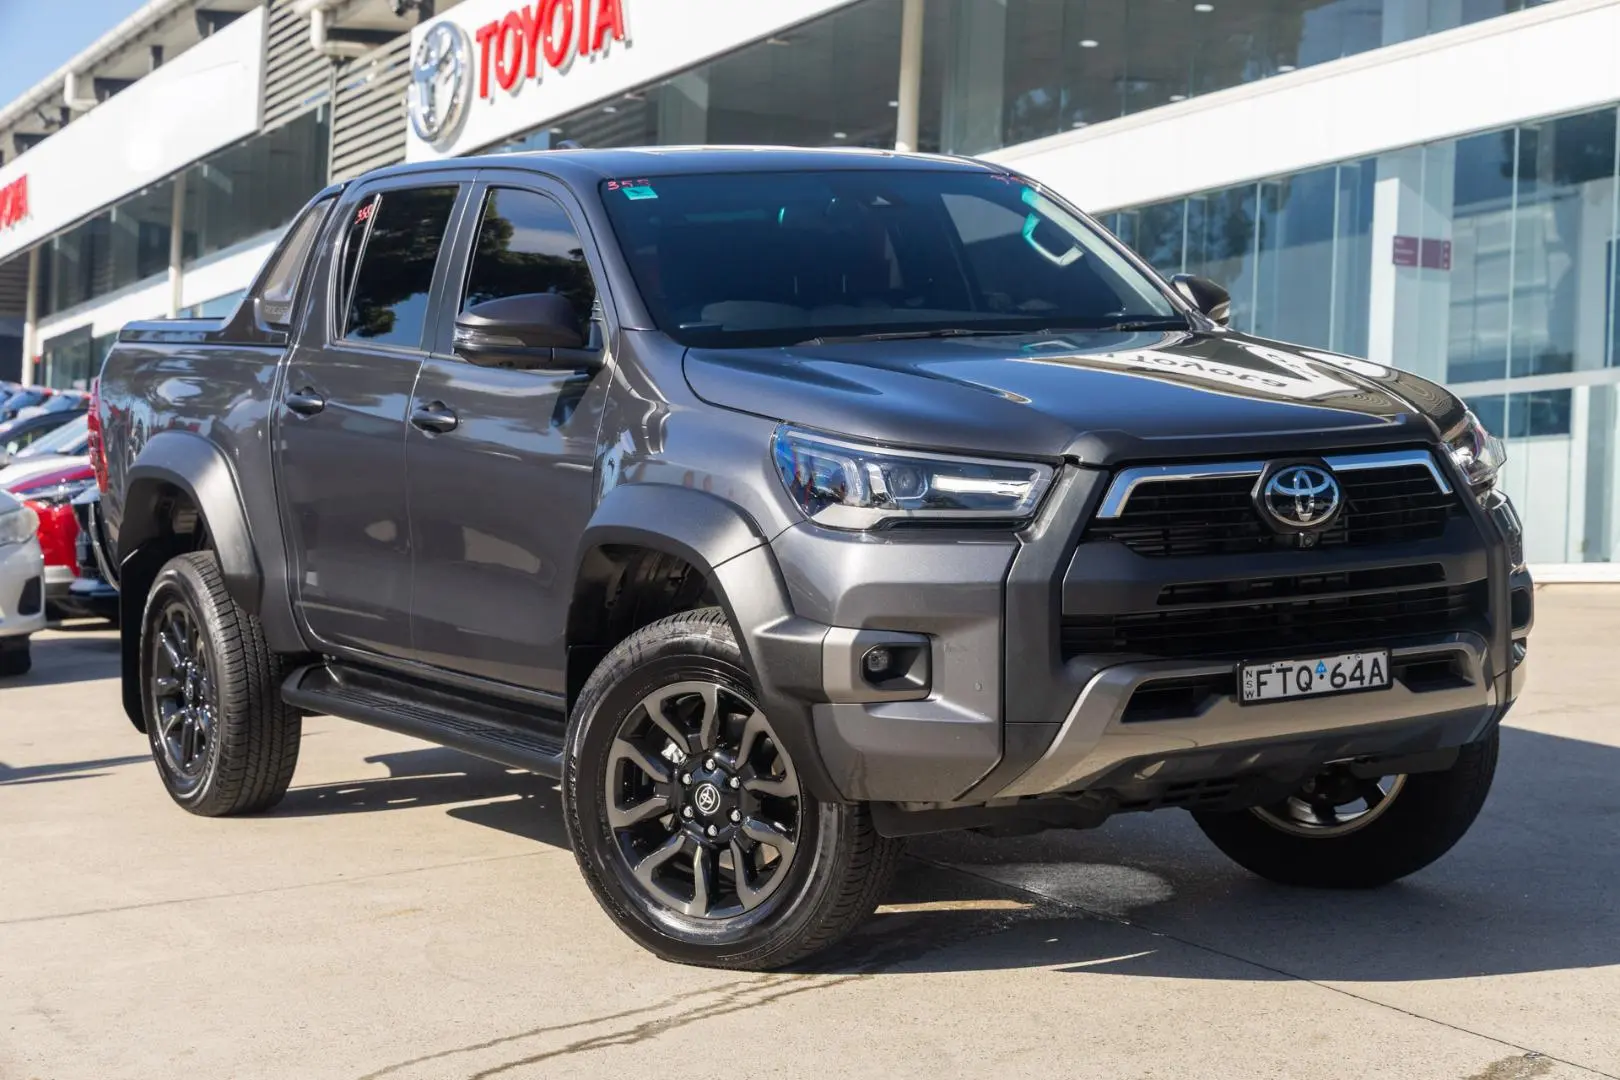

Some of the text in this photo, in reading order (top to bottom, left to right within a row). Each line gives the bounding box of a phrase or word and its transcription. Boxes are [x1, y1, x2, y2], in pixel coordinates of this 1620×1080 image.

[476, 0, 624, 99] TOYOTA
[1245, 670, 1254, 699] NSW
[1256, 657, 1385, 697] FTQ 64A
